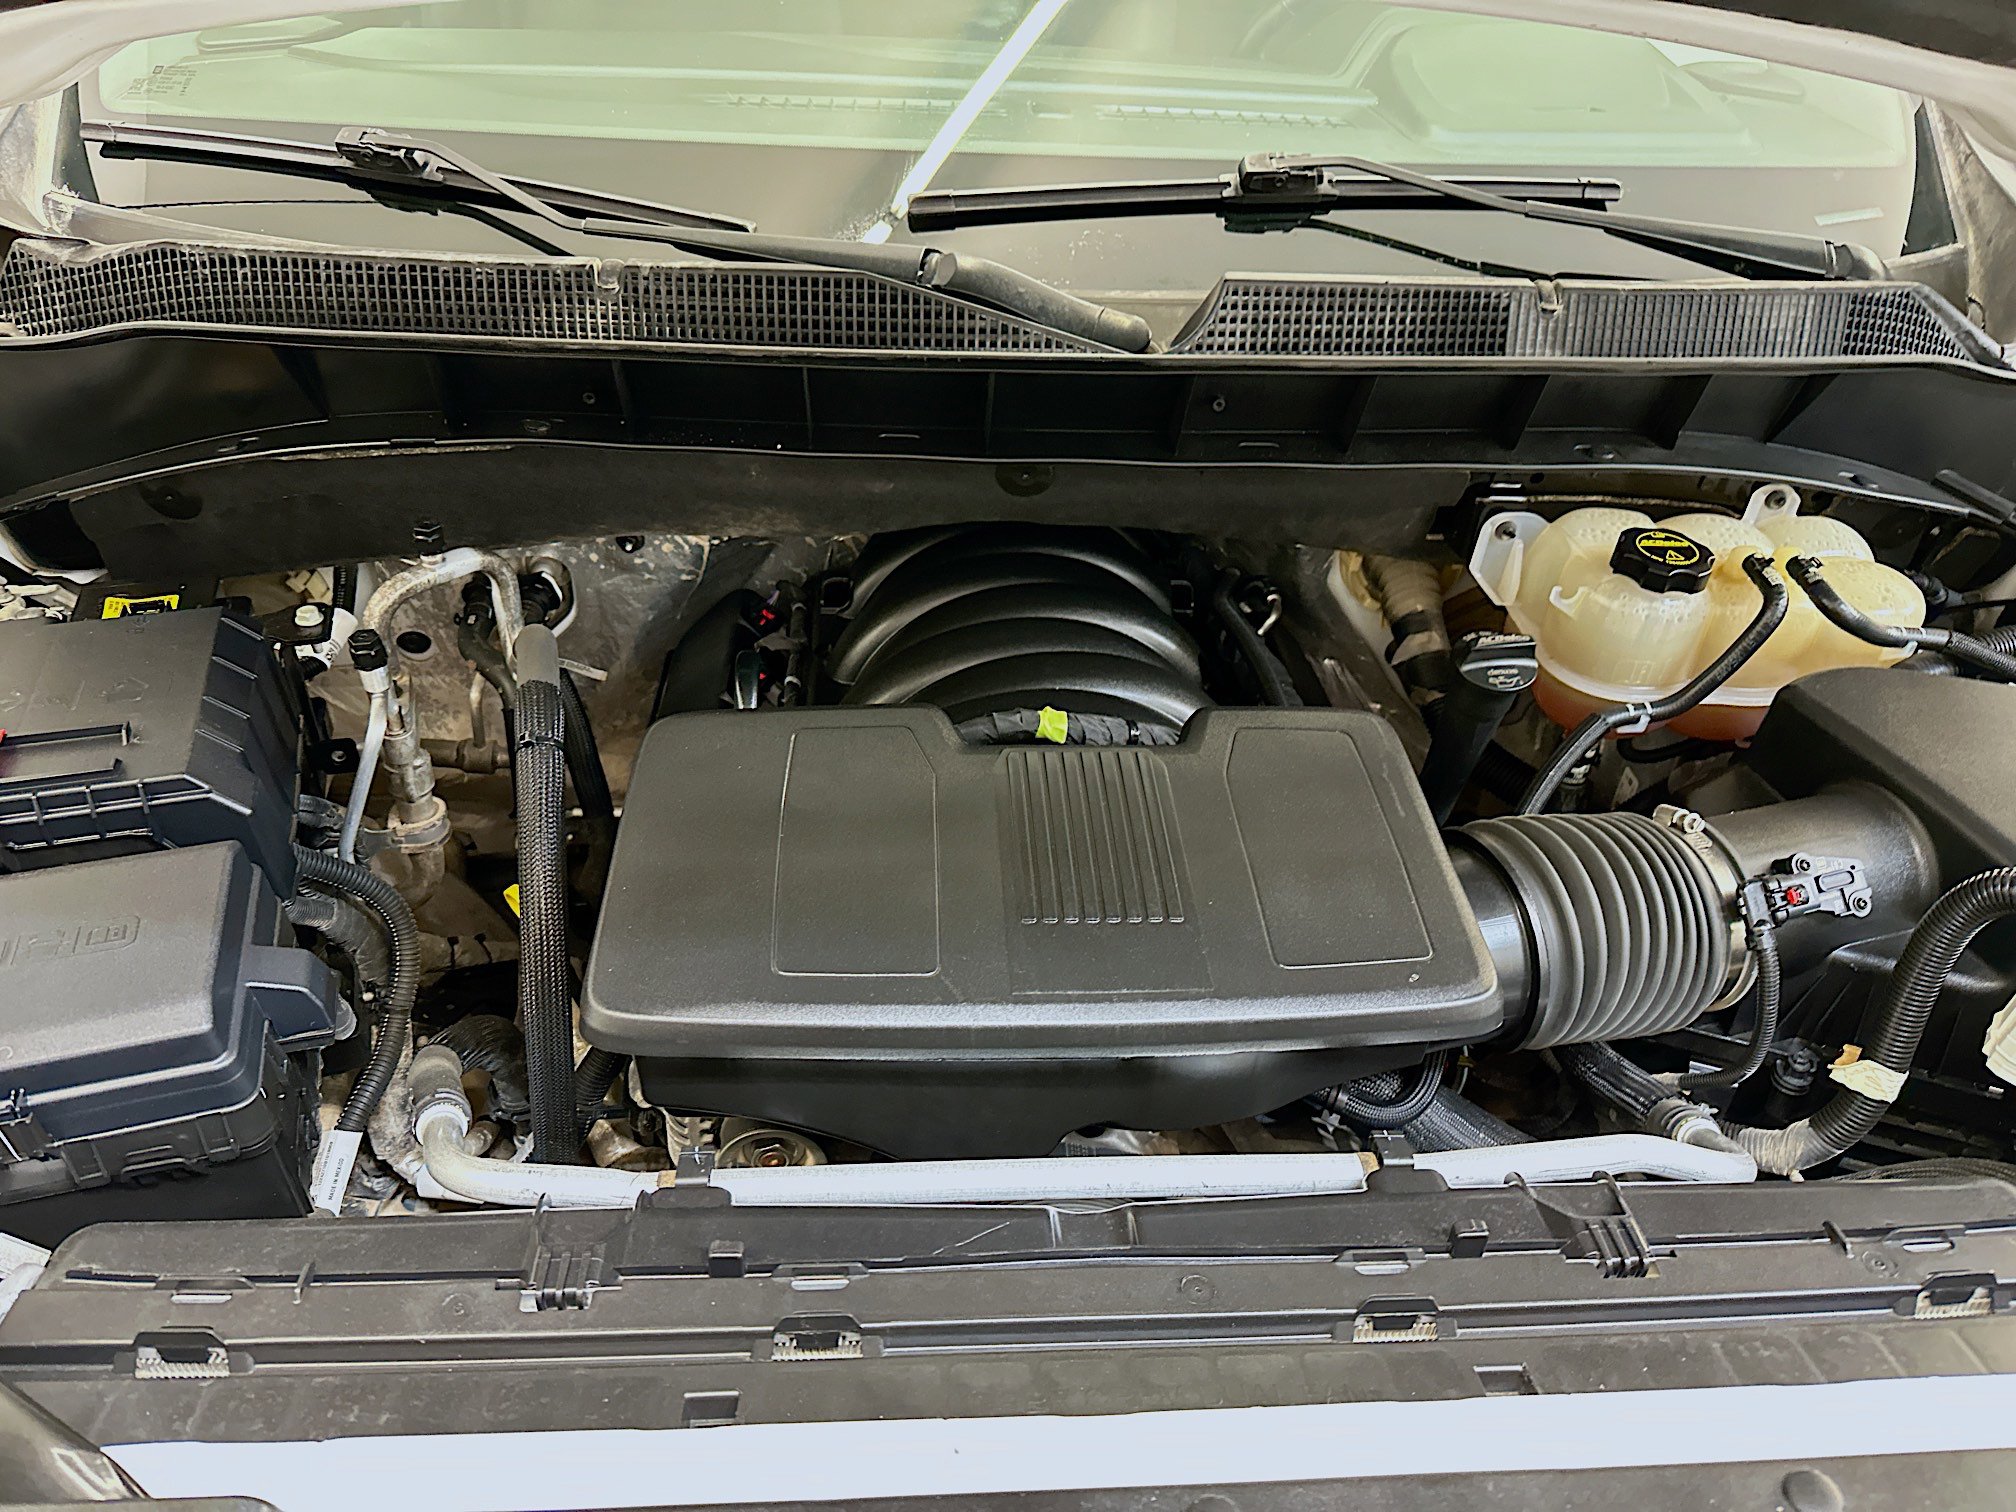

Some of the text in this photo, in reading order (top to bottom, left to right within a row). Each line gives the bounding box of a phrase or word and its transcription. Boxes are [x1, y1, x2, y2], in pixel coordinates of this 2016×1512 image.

[1478, 634, 1531, 645] ACDelco
[328, 1186, 336, 1200] MADE
[334, 1157, 345, 1178] MEXICO
